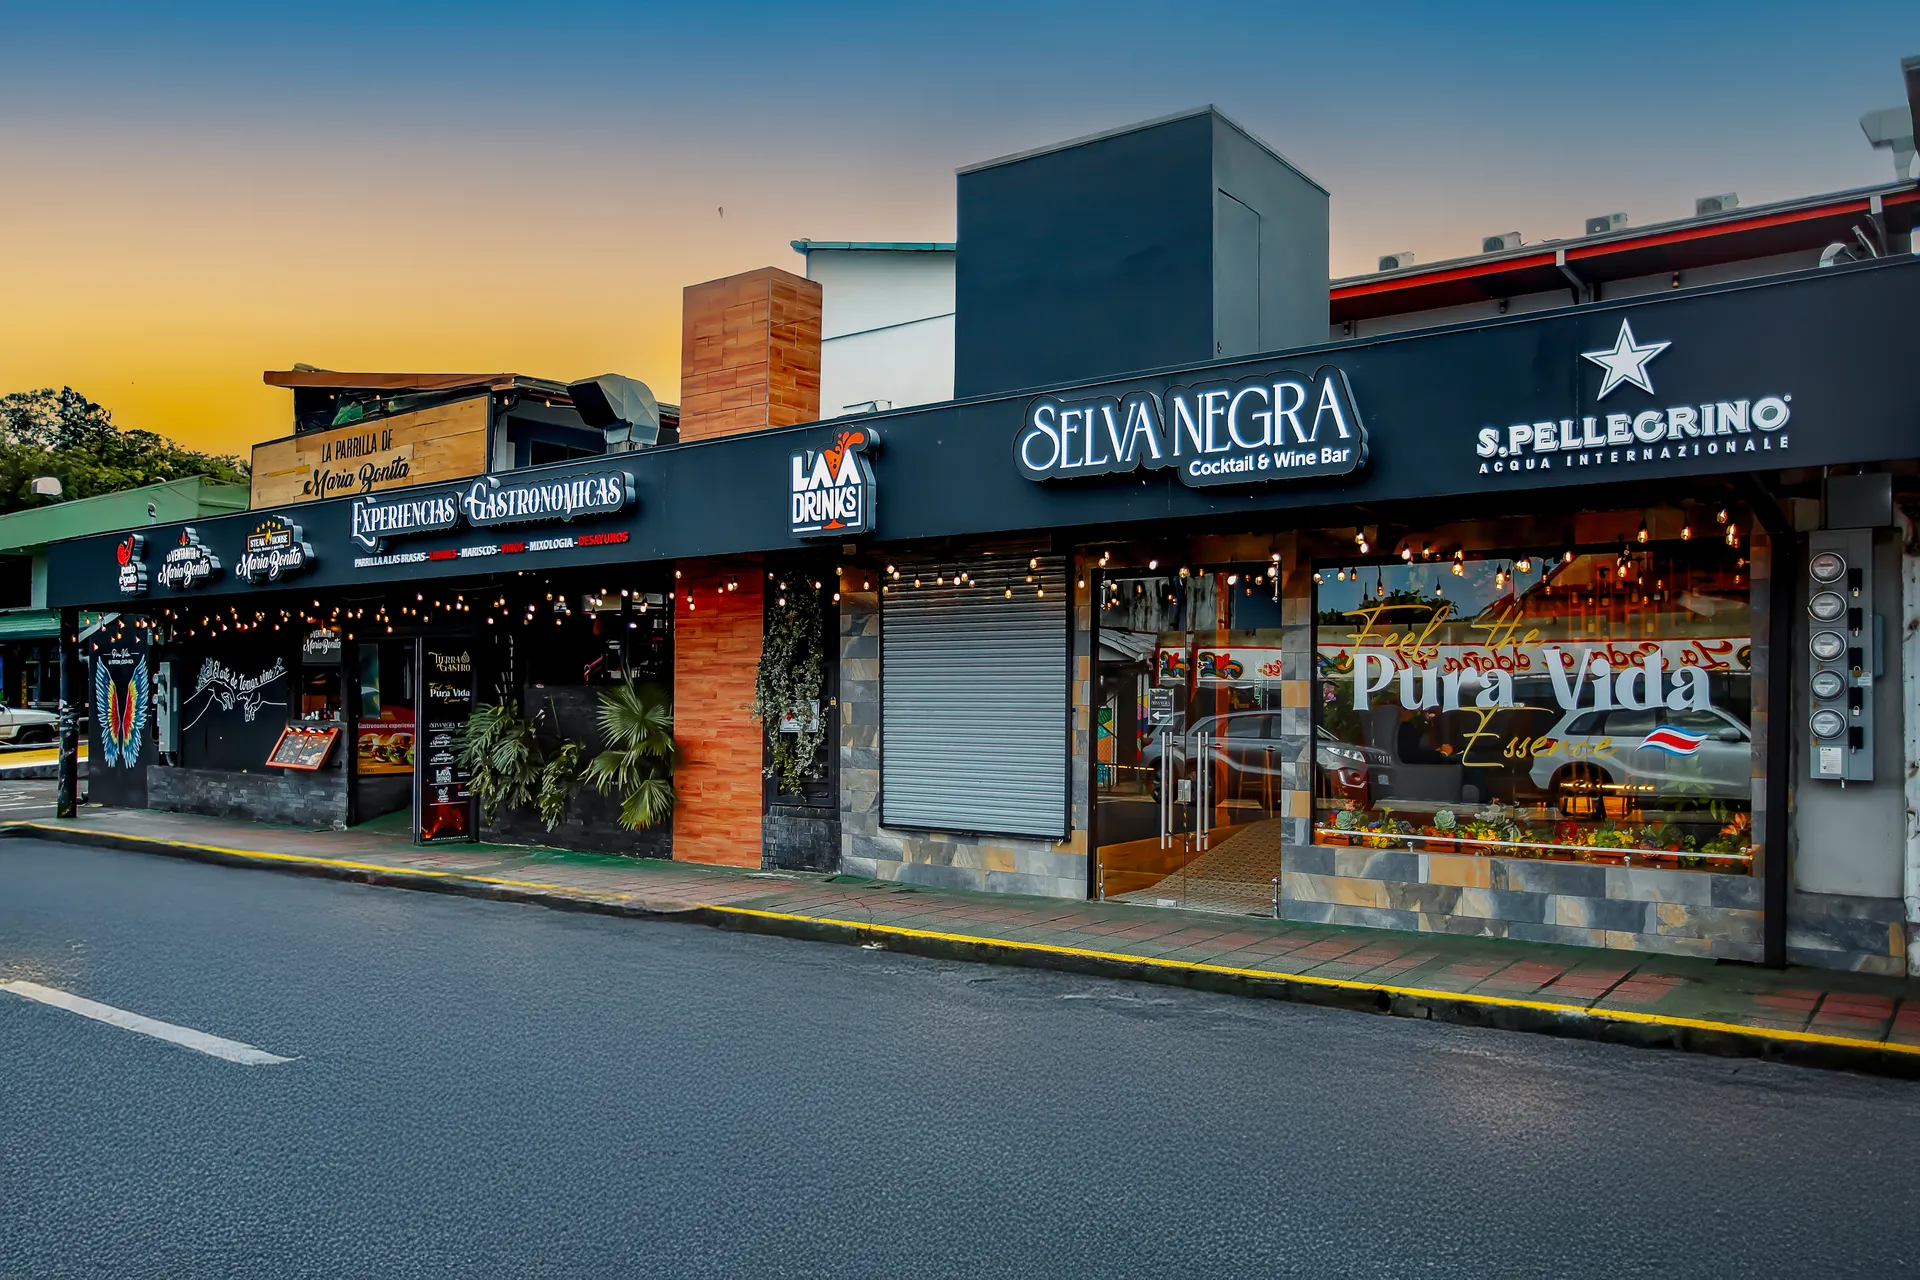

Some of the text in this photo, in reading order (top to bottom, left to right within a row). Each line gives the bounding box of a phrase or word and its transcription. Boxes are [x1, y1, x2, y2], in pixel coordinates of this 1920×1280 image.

[1022, 376, 1350, 471] SELVA NEGRA
[1476, 396, 1791, 458] S.PELLEGRINO
[322, 429, 393, 463] LA PARRILLA DE
[1189, 447, 1350, 477] Cocktail & Wine Bar
[1479, 436, 1789, 474] ACQUA INTERNAZIONALE
[303, 456, 411, 498] Maria Bonita
[353, 477, 621, 547] EXPERIENCIAS GASTRONOMICAS
[792, 486, 857, 523] DRINKS
[272, 534, 288, 545] HOUSE
[400, 552, 426, 563] BRASAS
[461, 545, 497, 557] MARISCOS
[529, 537, 574, 551] MIXOLOGIA
[578, 531, 629, 547] DESAYUNOS
[158, 558, 210, 587] Maria Bonita
[236, 546, 302, 580] Maria Bonita
[1342, 603, 1547, 668] Feel the
[428, 651, 460, 664] TIERRA
[230, 671, 238, 689] de
[430, 688, 471, 697] Pura Vida
[1352, 648, 1714, 713] Pura Vida
[1459, 705, 1620, 769] Essence
